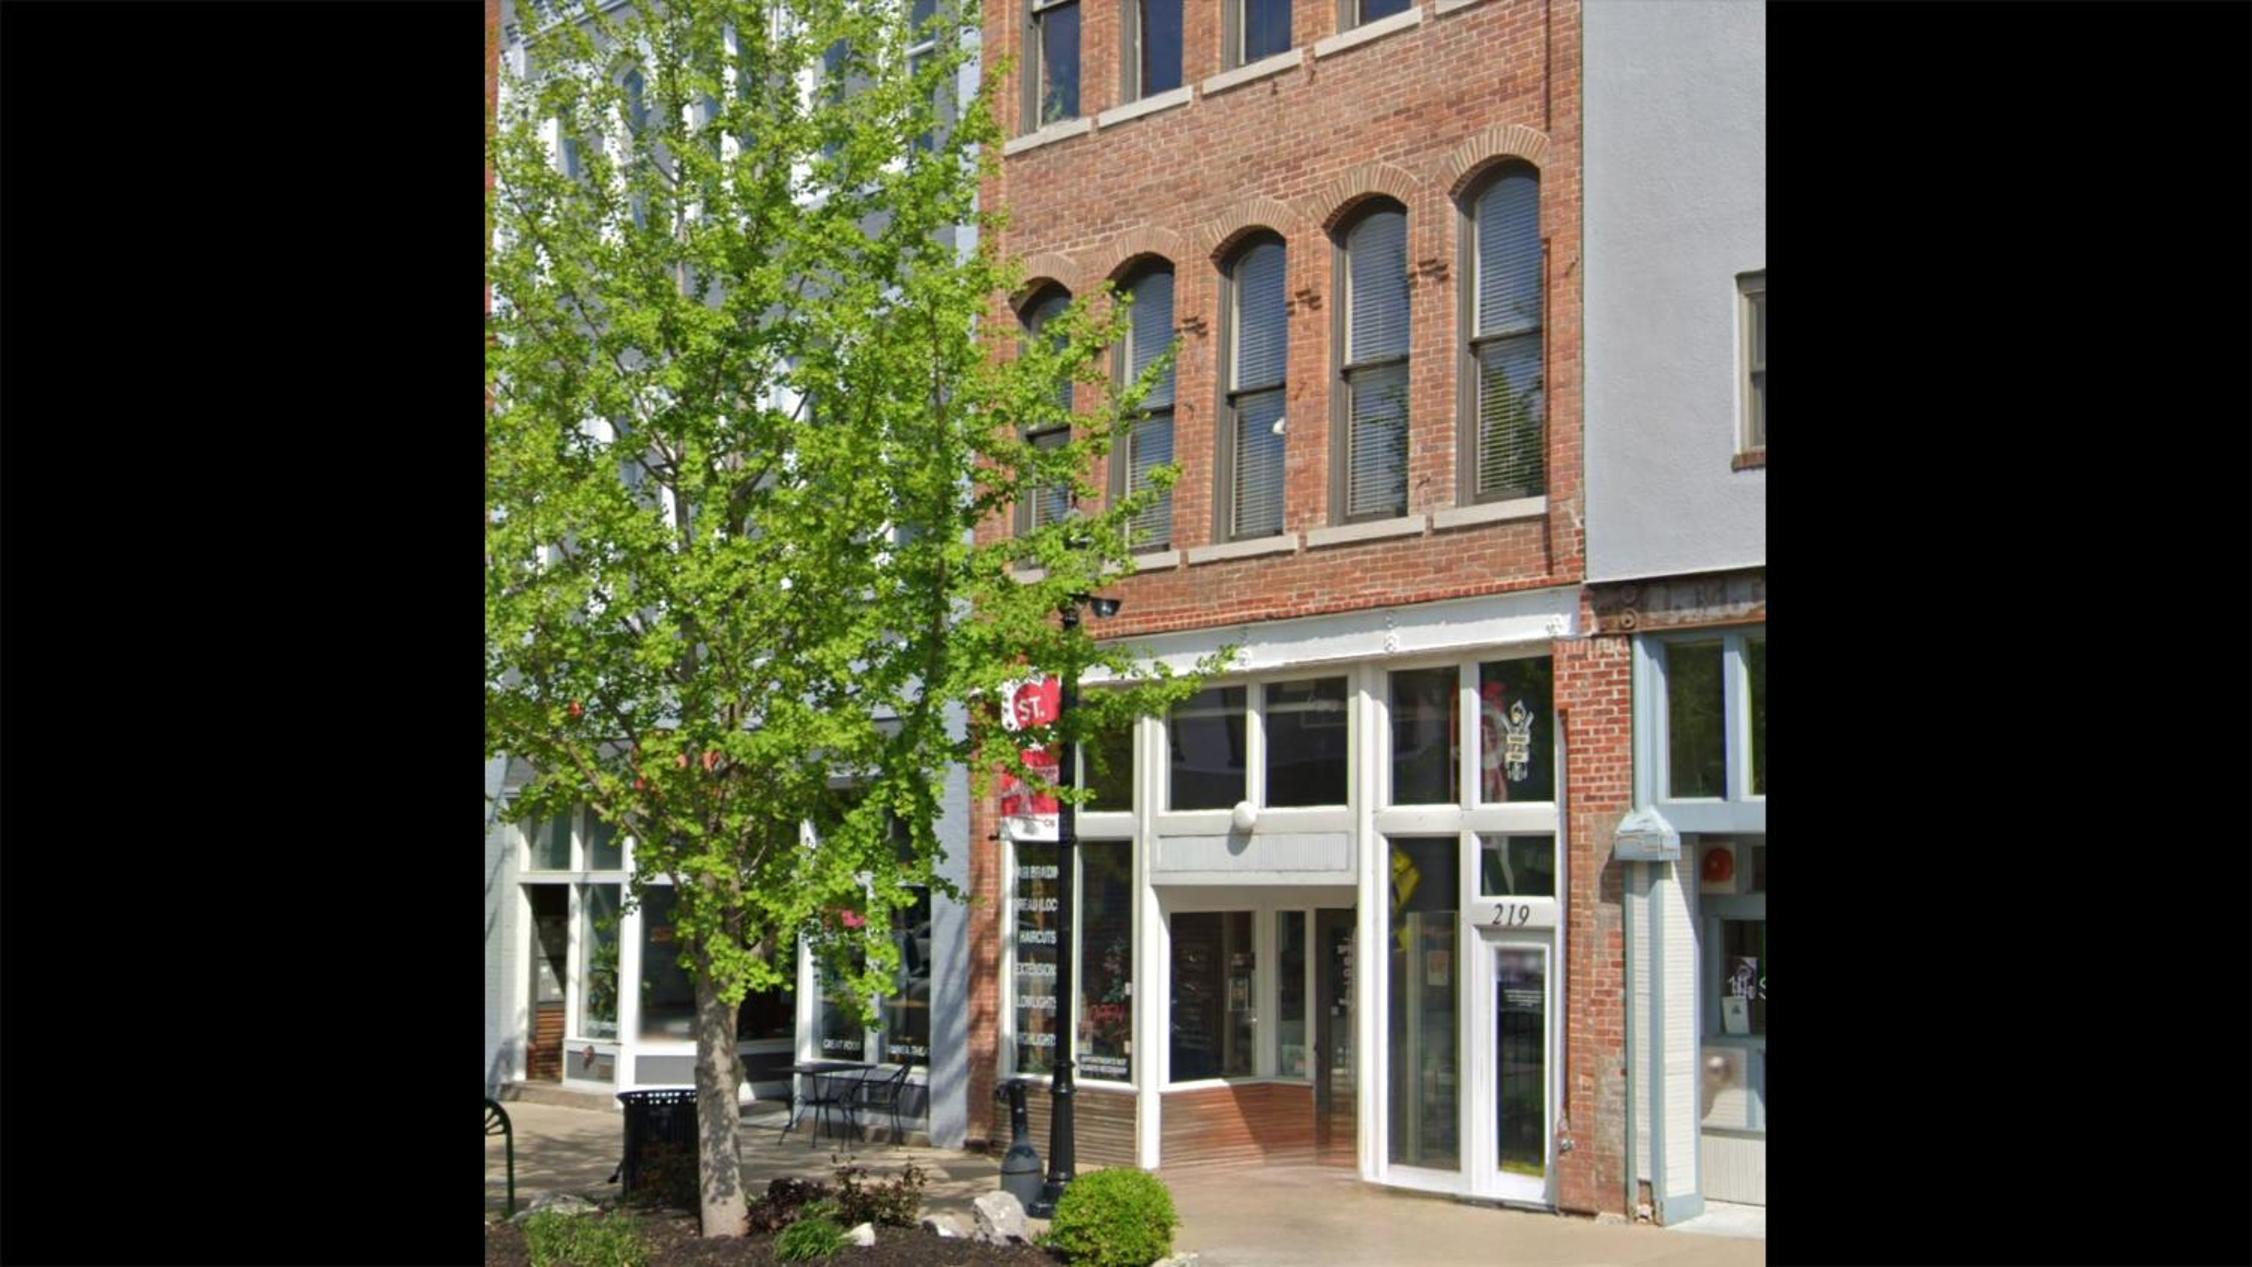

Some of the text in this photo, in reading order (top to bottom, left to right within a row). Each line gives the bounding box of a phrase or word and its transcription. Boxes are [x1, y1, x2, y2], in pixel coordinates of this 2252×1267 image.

[1017, 696, 1046, 721] ST.
[1492, 903, 1531, 926] 219
[1019, 930, 1057, 944] HAIRCUTS
